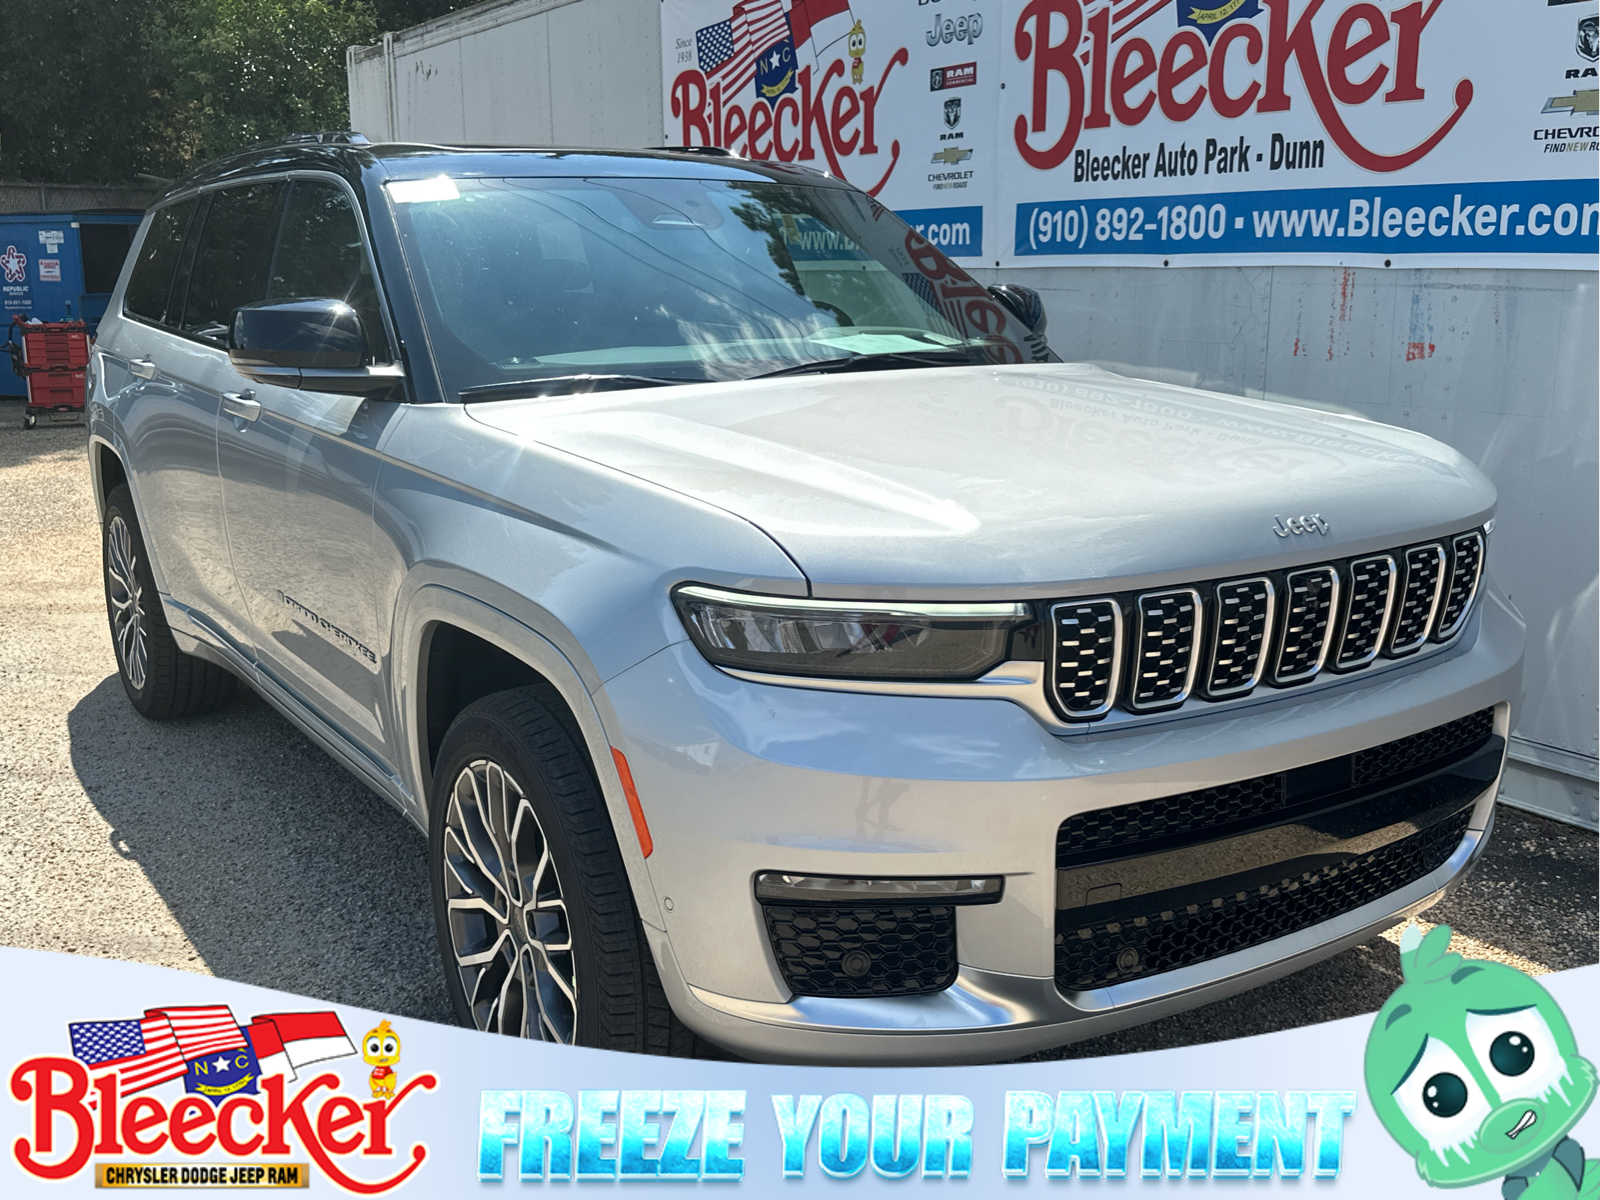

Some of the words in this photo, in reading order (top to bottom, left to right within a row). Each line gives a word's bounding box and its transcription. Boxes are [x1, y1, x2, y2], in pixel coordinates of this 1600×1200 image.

[926, 12, 983, 47] Jeep
[945, 66, 975, 79] RAM
[940, 131, 964, 141] RAM
[1074, 146, 1150, 183] Bleecker
[1154, 141, 1198, 178] Auto
[1204, 136, 1250, 175] Park
[1269, 132, 1325, 171] Dunn
[928, 170, 974, 182] CHEVROLET
[1029, 205, 1088, 249] (910)
[1095, 202, 1226, 243] 892-1800
[1272, 513, 1329, 538] Jeep
